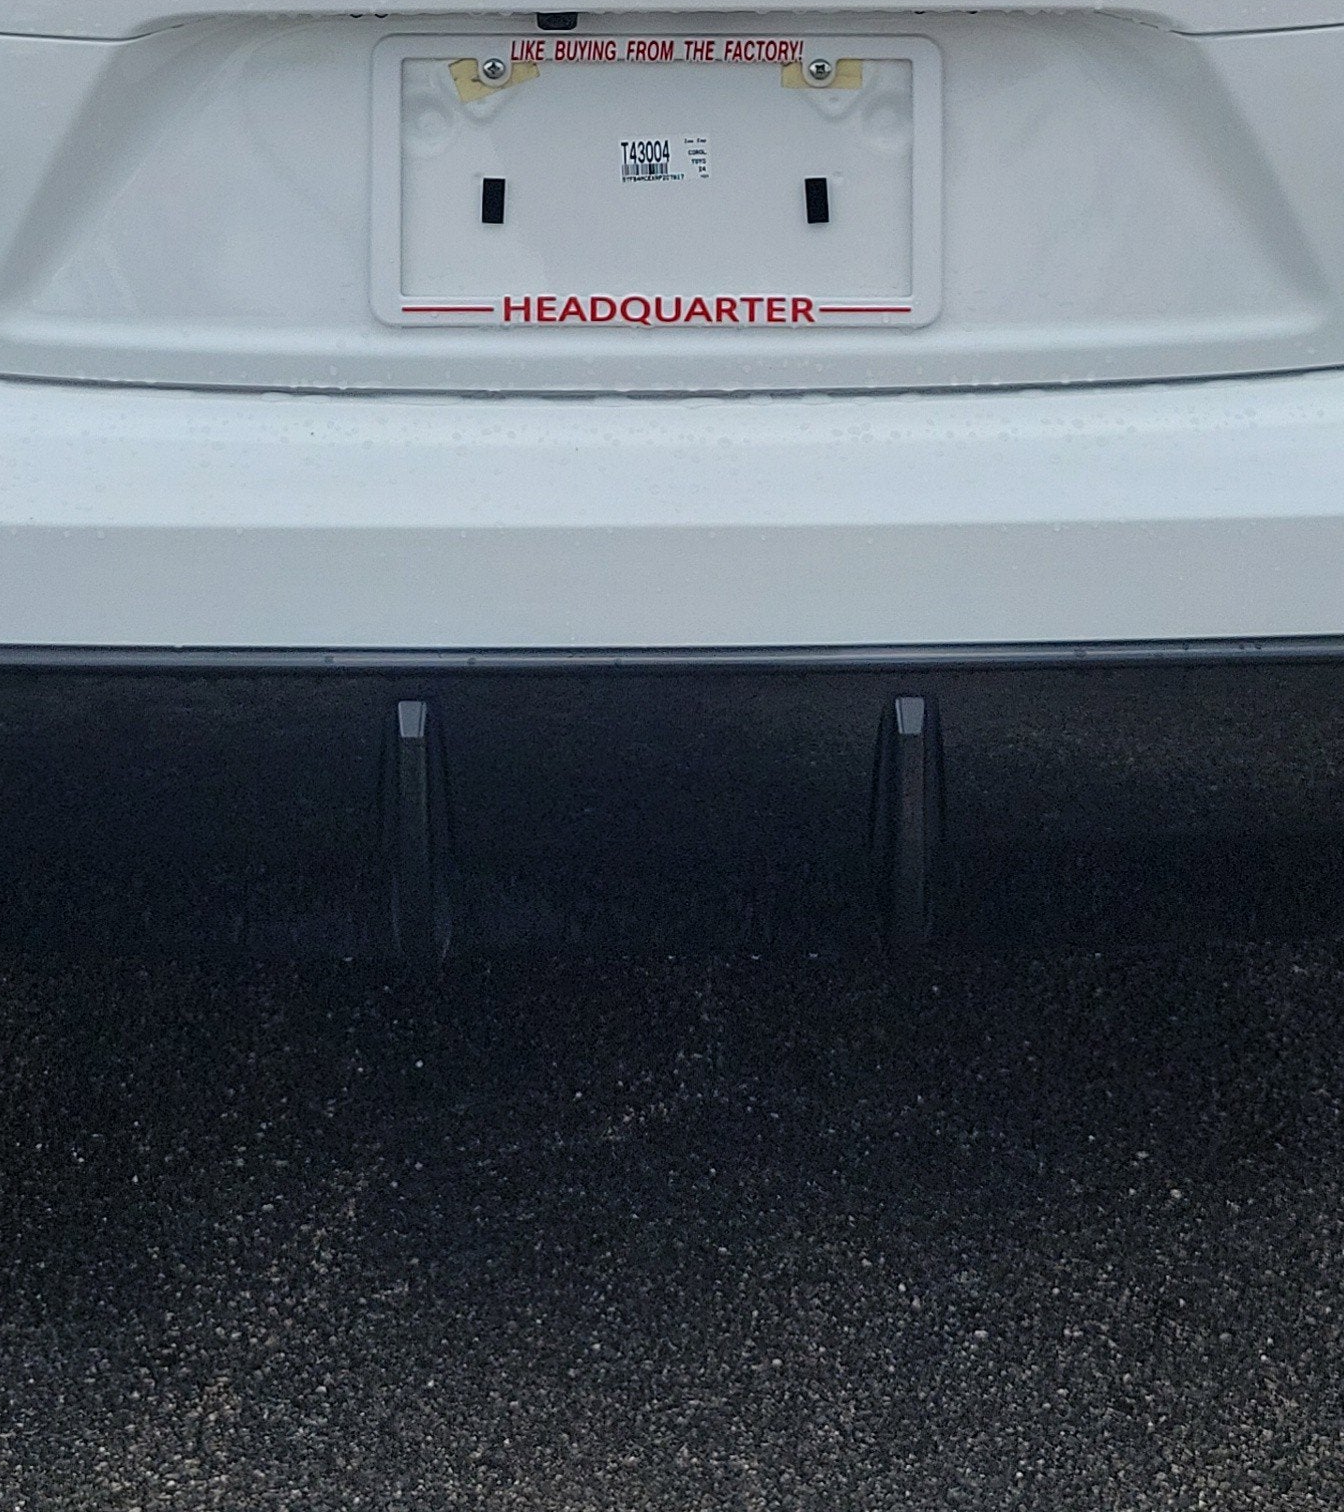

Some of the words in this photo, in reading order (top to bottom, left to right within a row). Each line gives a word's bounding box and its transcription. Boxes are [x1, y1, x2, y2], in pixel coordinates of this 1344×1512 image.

[510, 39, 545, 62] LIKE
[554, 39, 617, 62] BUYING
[626, 39, 674, 62] FROM
[683, 39, 716, 62] THE
[723, 39, 805, 62] FACTORY!
[620, 139, 671, 164] T43004
[502, 295, 816, 326] HEADQUARTER
